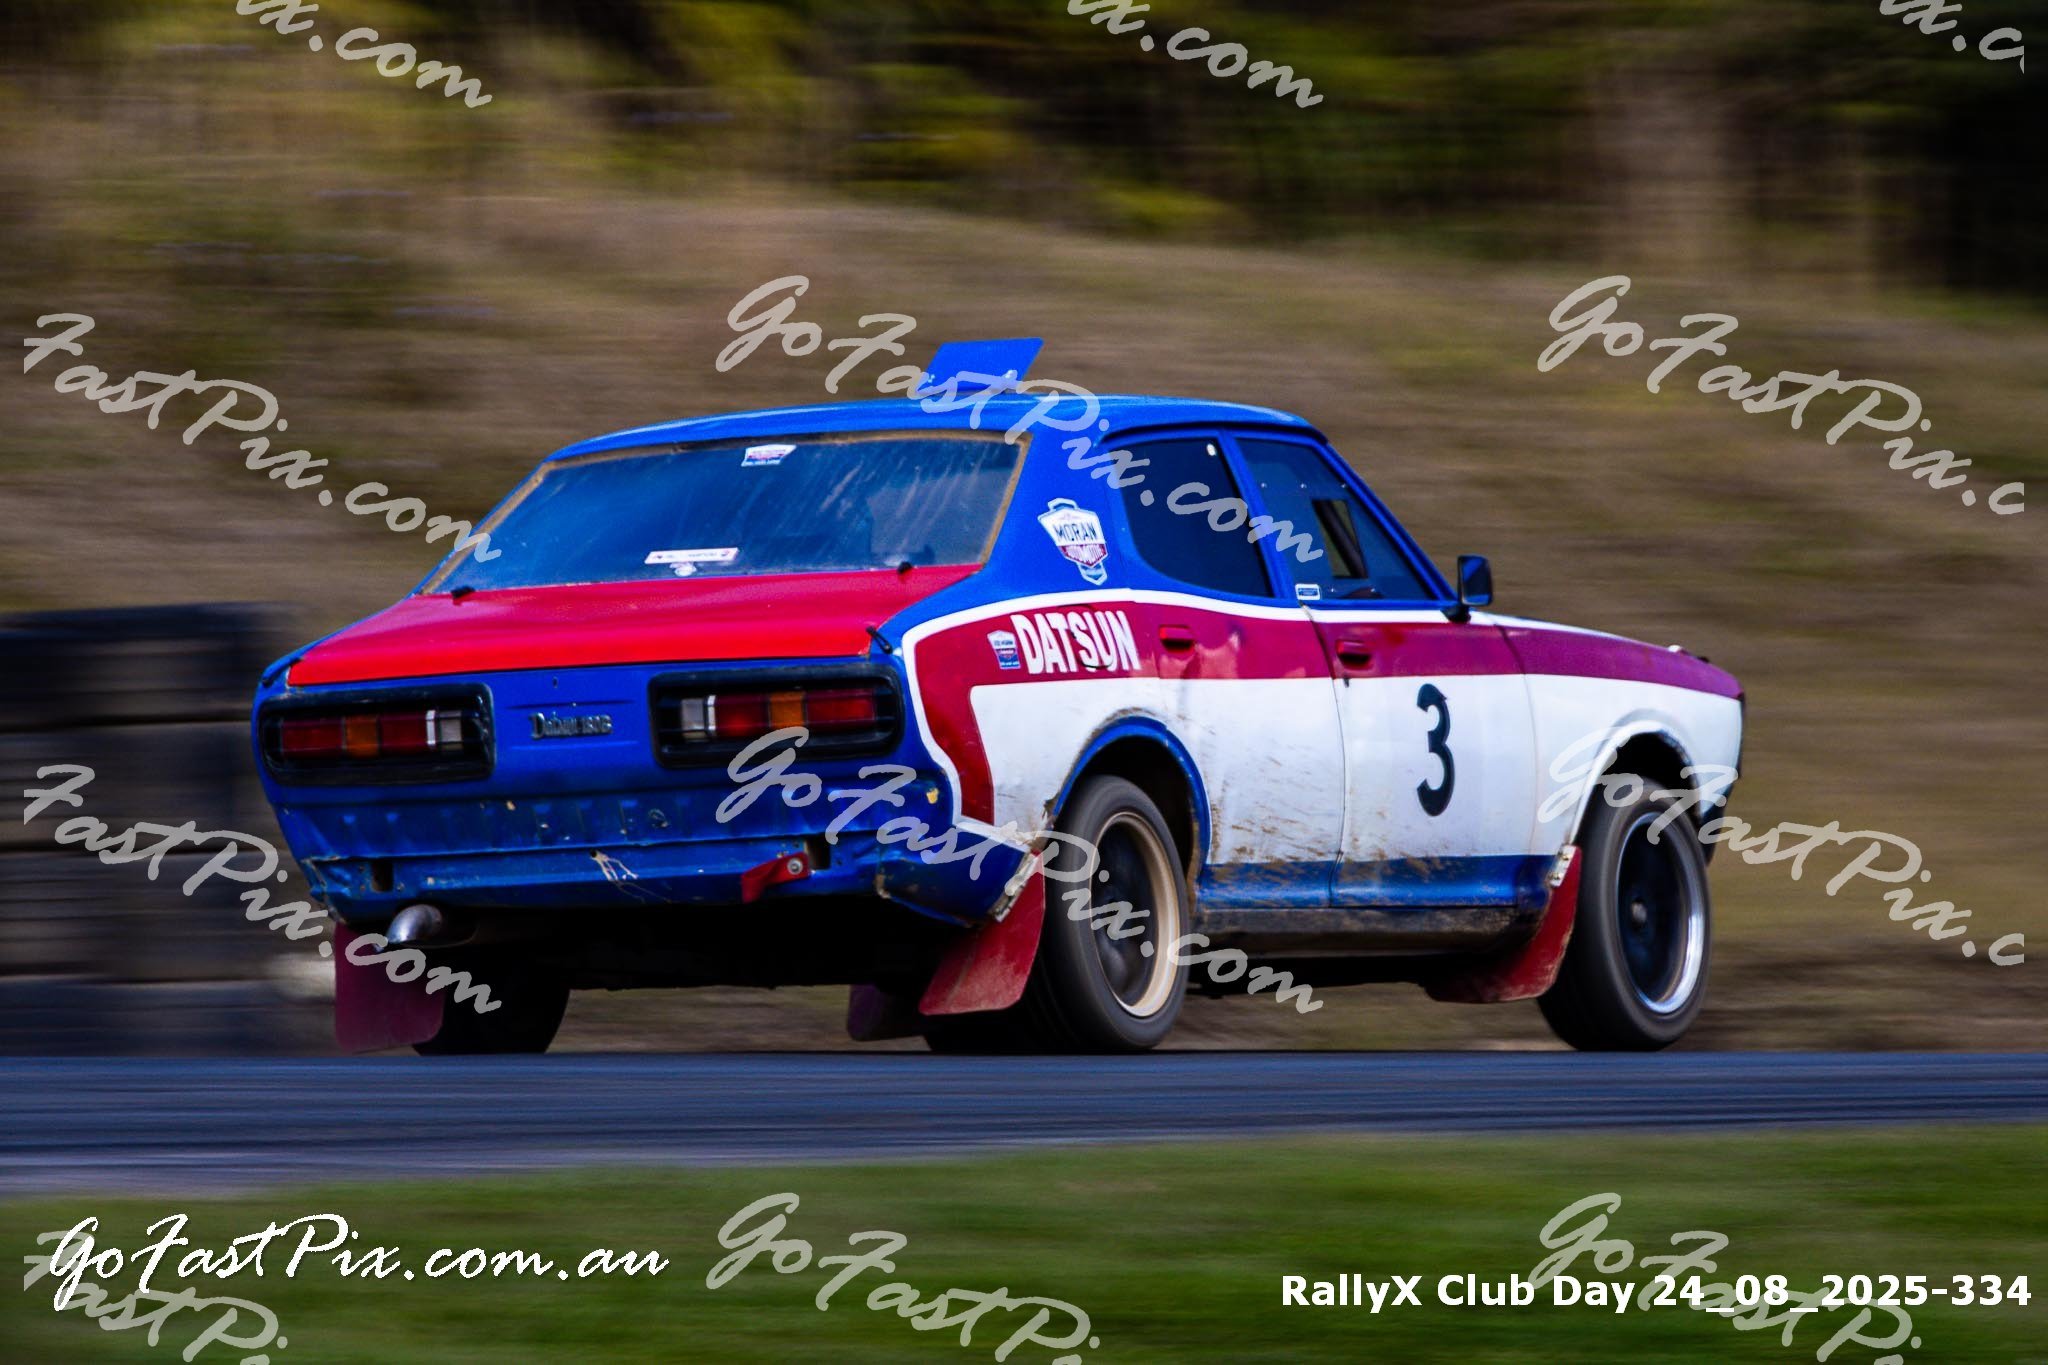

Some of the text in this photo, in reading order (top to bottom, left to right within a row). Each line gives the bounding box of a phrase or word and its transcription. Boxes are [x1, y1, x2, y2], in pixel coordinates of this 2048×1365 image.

[1052, 521, 1098, 543] MORAN
[1010, 610, 1142, 675] DATSUN
[1416, 683, 1455, 817] 3
